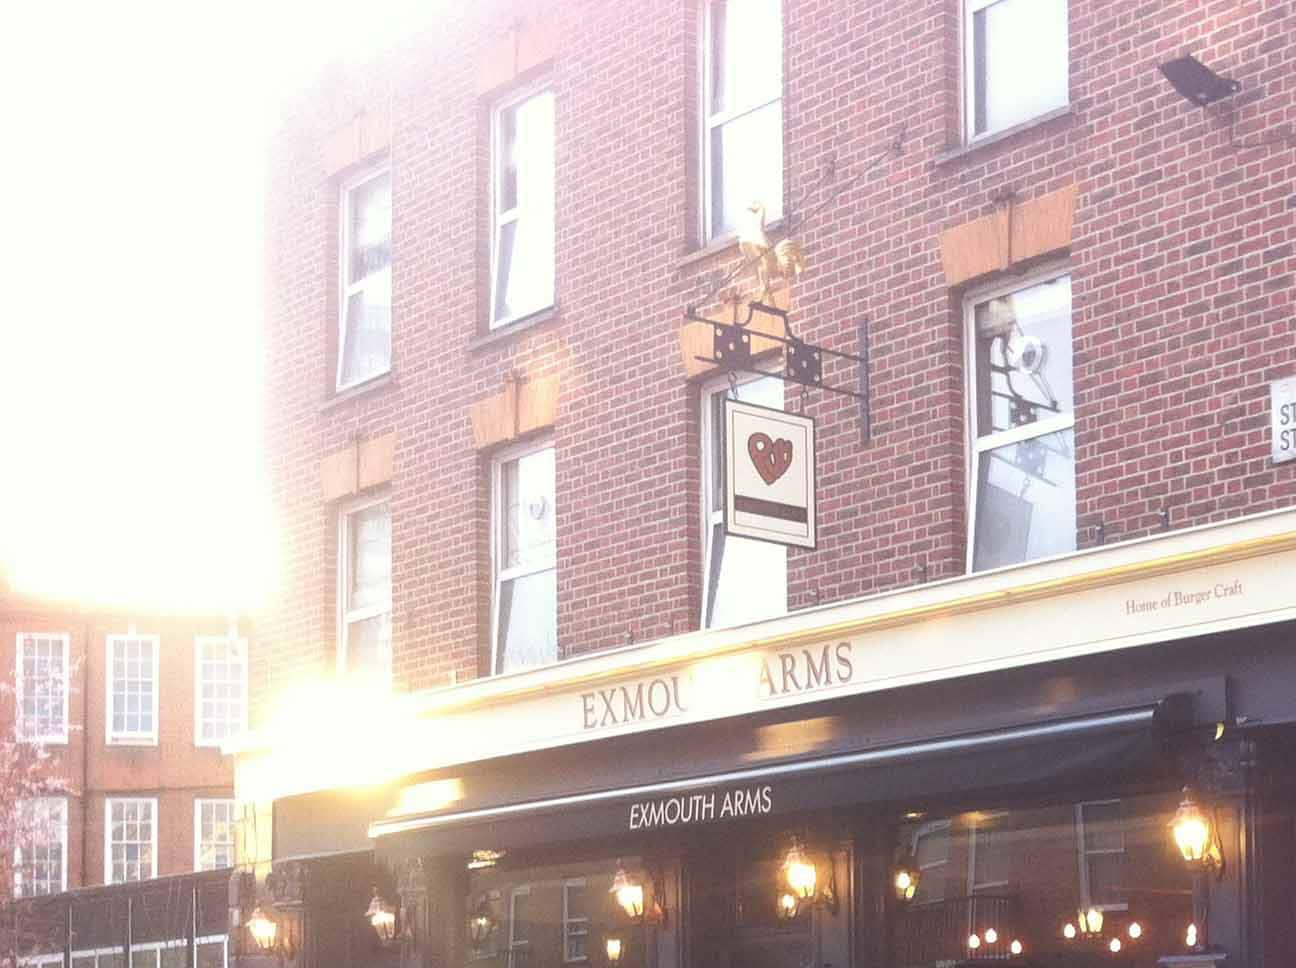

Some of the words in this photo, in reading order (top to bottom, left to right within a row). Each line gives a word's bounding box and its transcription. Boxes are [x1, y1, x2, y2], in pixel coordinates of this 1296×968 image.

[1126, 599, 1159, 615] Home
[1173, 589, 1212, 607] Burger
[581, 675, 688, 730] EXMOU
[759, 641, 853, 698] ARMS
[629, 794, 715, 830] EXMOUTH
[720, 785, 772, 819] ARMS
